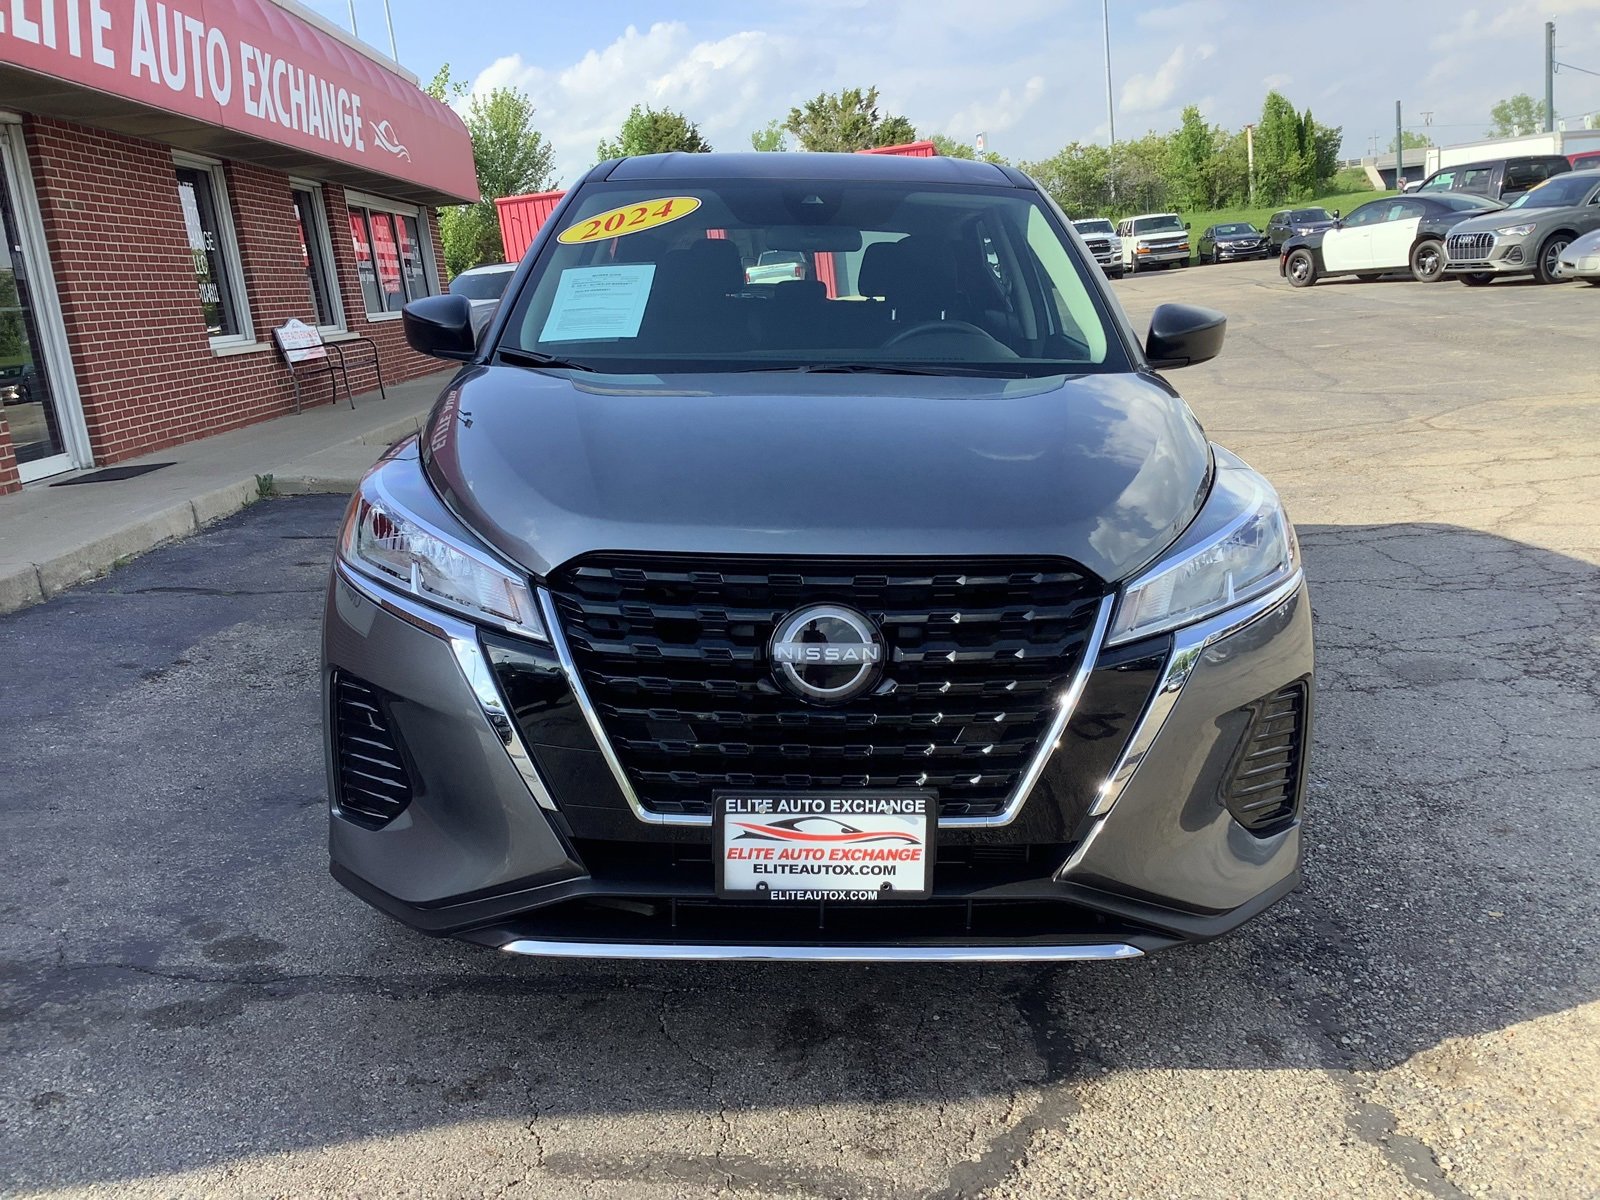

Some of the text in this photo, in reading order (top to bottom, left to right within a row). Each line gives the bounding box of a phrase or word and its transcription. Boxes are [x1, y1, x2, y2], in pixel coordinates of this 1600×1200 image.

[0, 0, 364, 152] LITE AUTO EXCHANGE
[580, 199, 674, 240] 2024
[777, 646, 878, 661] NISSAN
[725, 799, 926, 814] ELITE AUTO EXCHANGE
[726, 847, 923, 861] ELITE AUTO EXCHANGE
[753, 863, 897, 876] ELITEAUTOX.COM
[770, 890, 878, 900] ELITEAUTOX.COM
